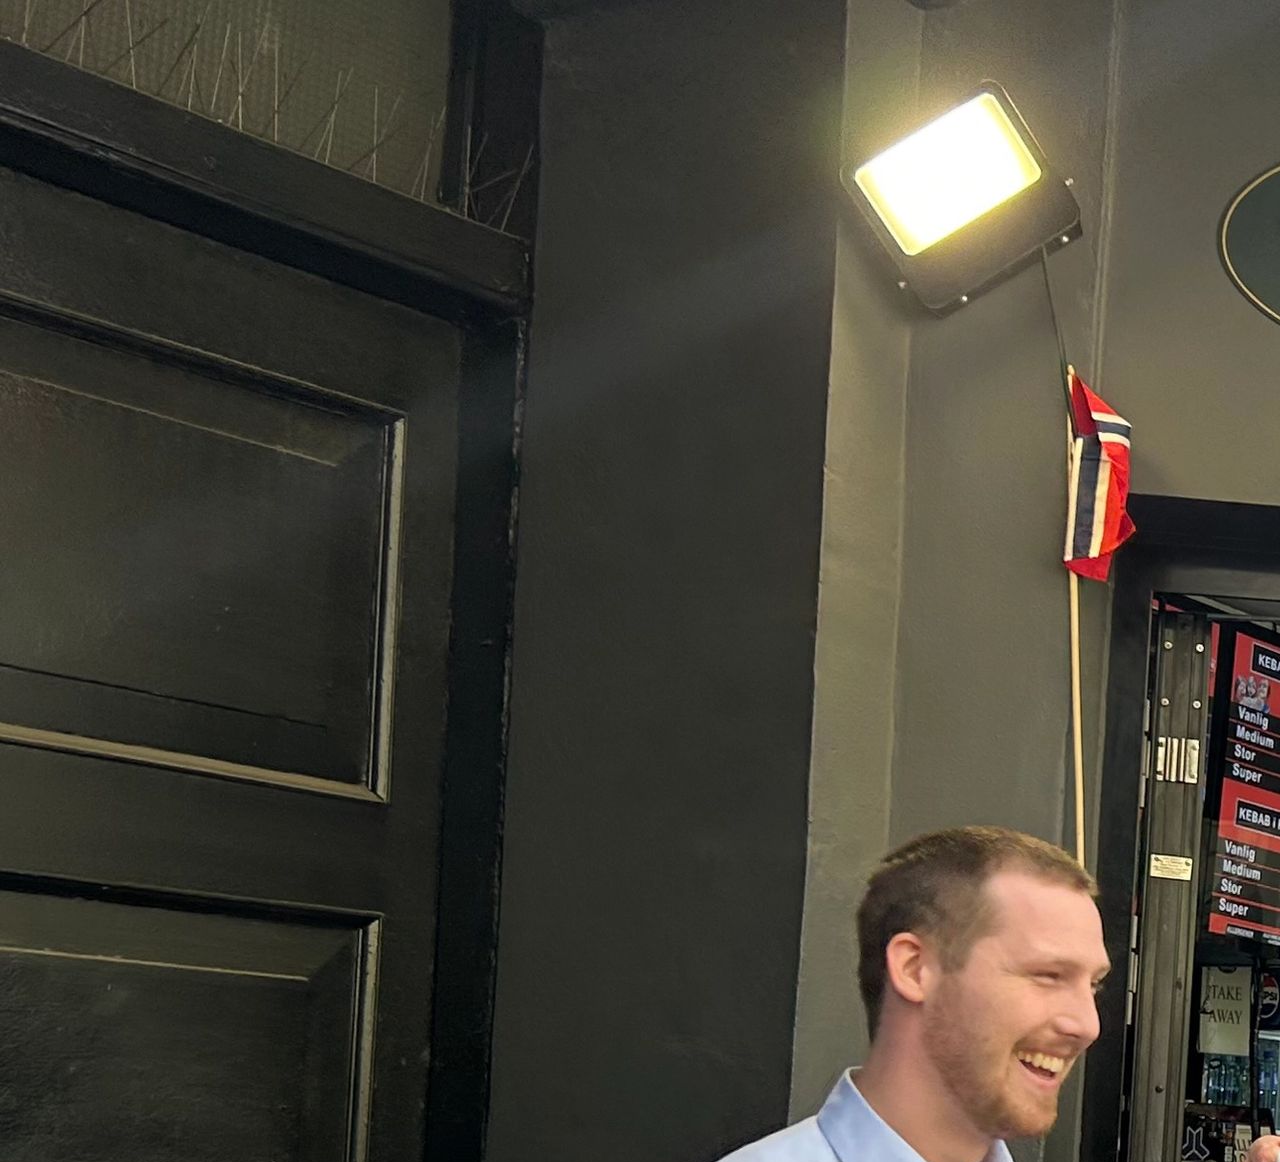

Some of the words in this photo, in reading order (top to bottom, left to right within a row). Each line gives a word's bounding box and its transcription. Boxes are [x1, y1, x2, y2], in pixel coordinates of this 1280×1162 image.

[1238, 705, 1269, 731] Vanlig
[1236, 725, 1275, 750] Medium
[1234, 744, 1256, 761] Stor
[1232, 763, 1262, 784] Super
[1238, 807, 1271, 827] KEBAB
[1224, 840, 1256, 863] Vanlig
[1222, 859, 1261, 881] Medium
[1220, 878, 1242, 896] Stor
[1218, 897, 1249, 917] Super
[1211, 984, 1242, 1001] TAKE
[1208, 1010, 1243, 1025] AWAY
